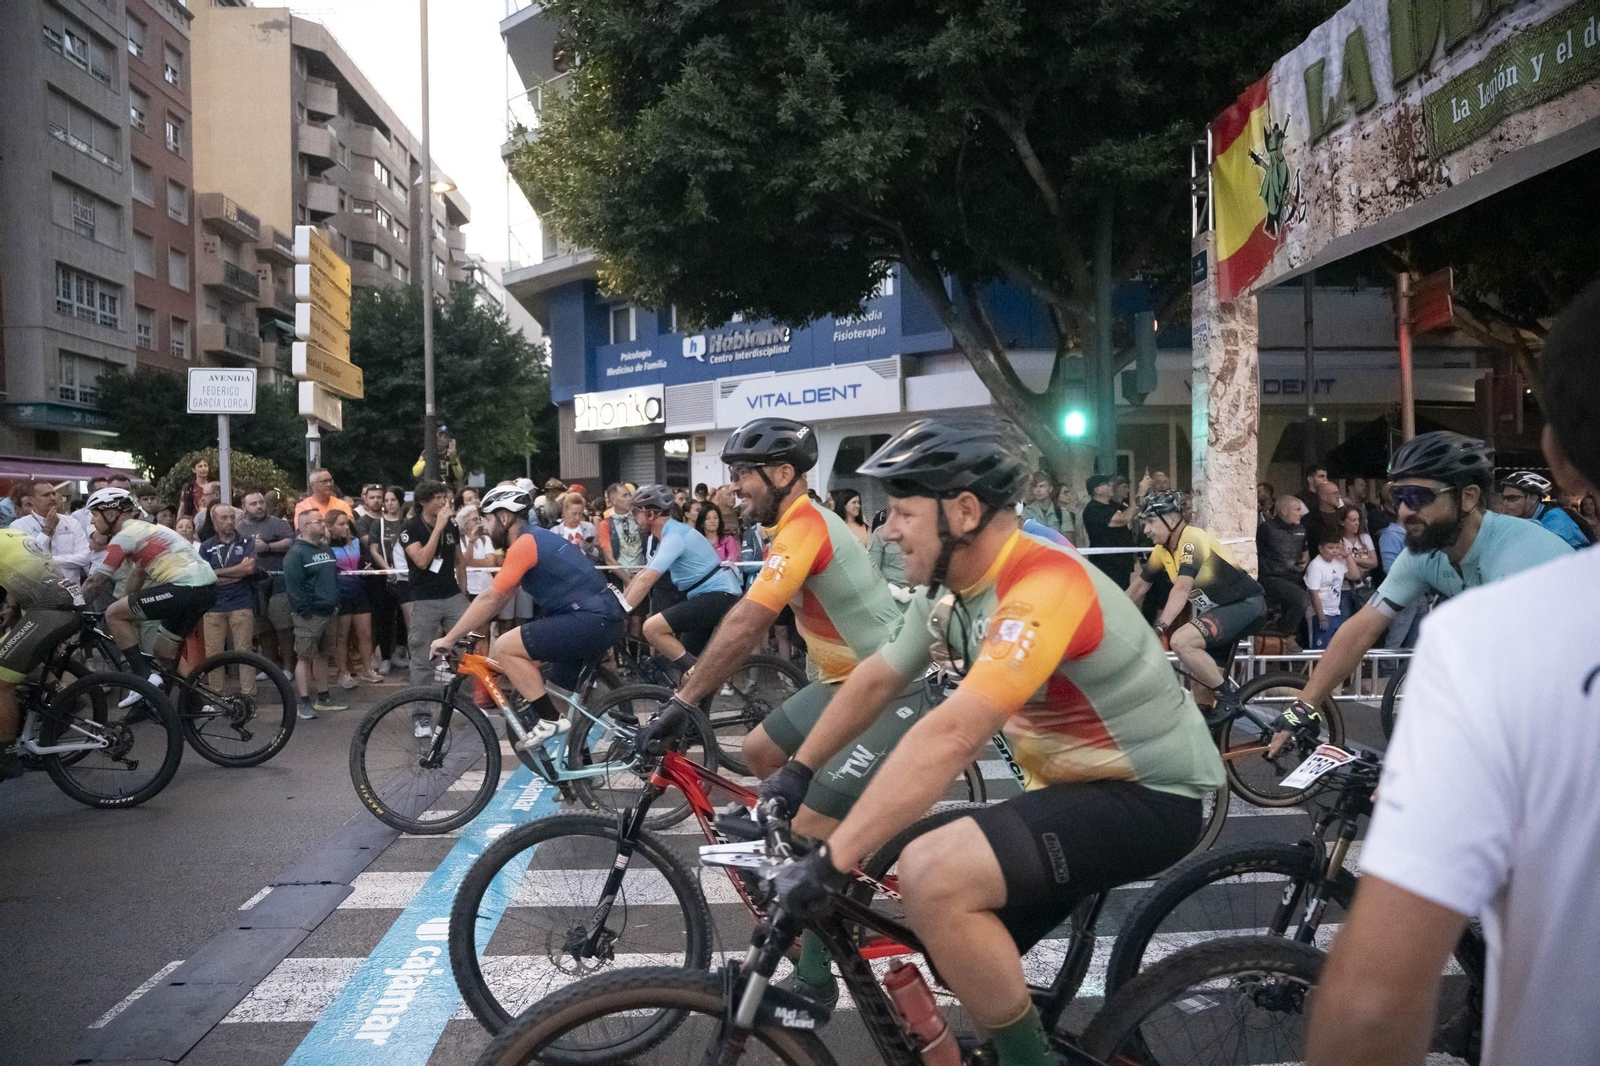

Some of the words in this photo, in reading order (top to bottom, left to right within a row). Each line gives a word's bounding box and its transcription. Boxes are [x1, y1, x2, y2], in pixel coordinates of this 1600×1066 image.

[1451, 97, 1471, 124] La
[1477, 64, 1518, 109] Legión
[1530, 52, 1545, 83] y
[1556, 29, 1574, 64] el
[835, 310, 883, 327] Logpedia
[833, 325, 886, 342] Fisioterapia
[709, 354, 734, 365] Centro
[734, 344, 791, 361] Interdisciplinar
[606, 365, 634, 376] Medicina
[634, 363, 644, 372] de
[644, 359, 667, 370] Familia
[208, 374, 251, 382] AVENIDA
[202, 385, 240, 396] FEDERICO
[746, 384, 862, 409] VITALDENT
[223, 398, 249, 408] LORCA
[140, 596, 155, 604] TEAM
[841, 744, 876, 778] TW
[100, 795, 135, 804] MAXXIS
[359, 784, 384, 815] MAXXIS
[855, 873, 902, 901] FSR
[354, 945, 444, 1046] cajamar
